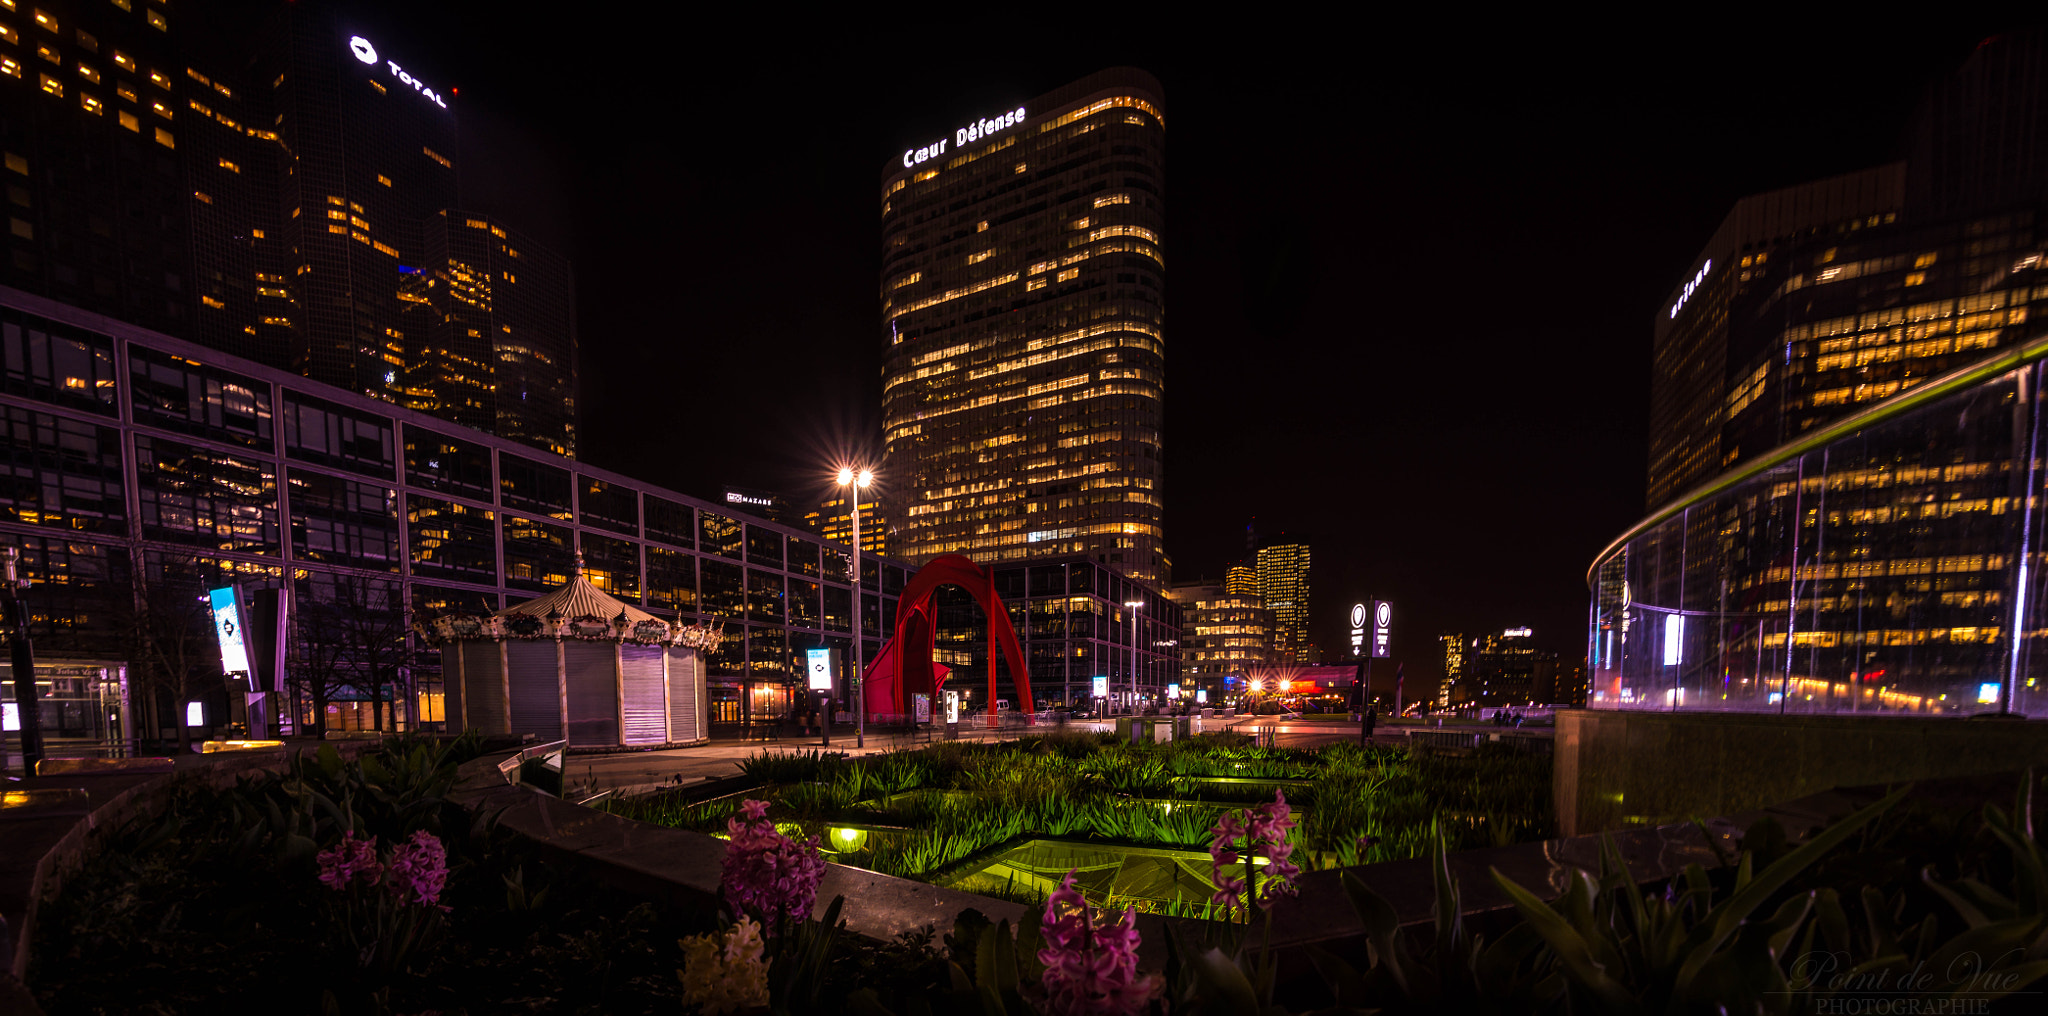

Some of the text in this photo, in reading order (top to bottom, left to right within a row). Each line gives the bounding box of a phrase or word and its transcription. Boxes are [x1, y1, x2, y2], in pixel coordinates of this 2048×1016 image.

[387, 60, 446, 108] TOTAL
[903, 107, 1025, 168] Cœur Défense
[742, 496, 772, 506] MAZARS
